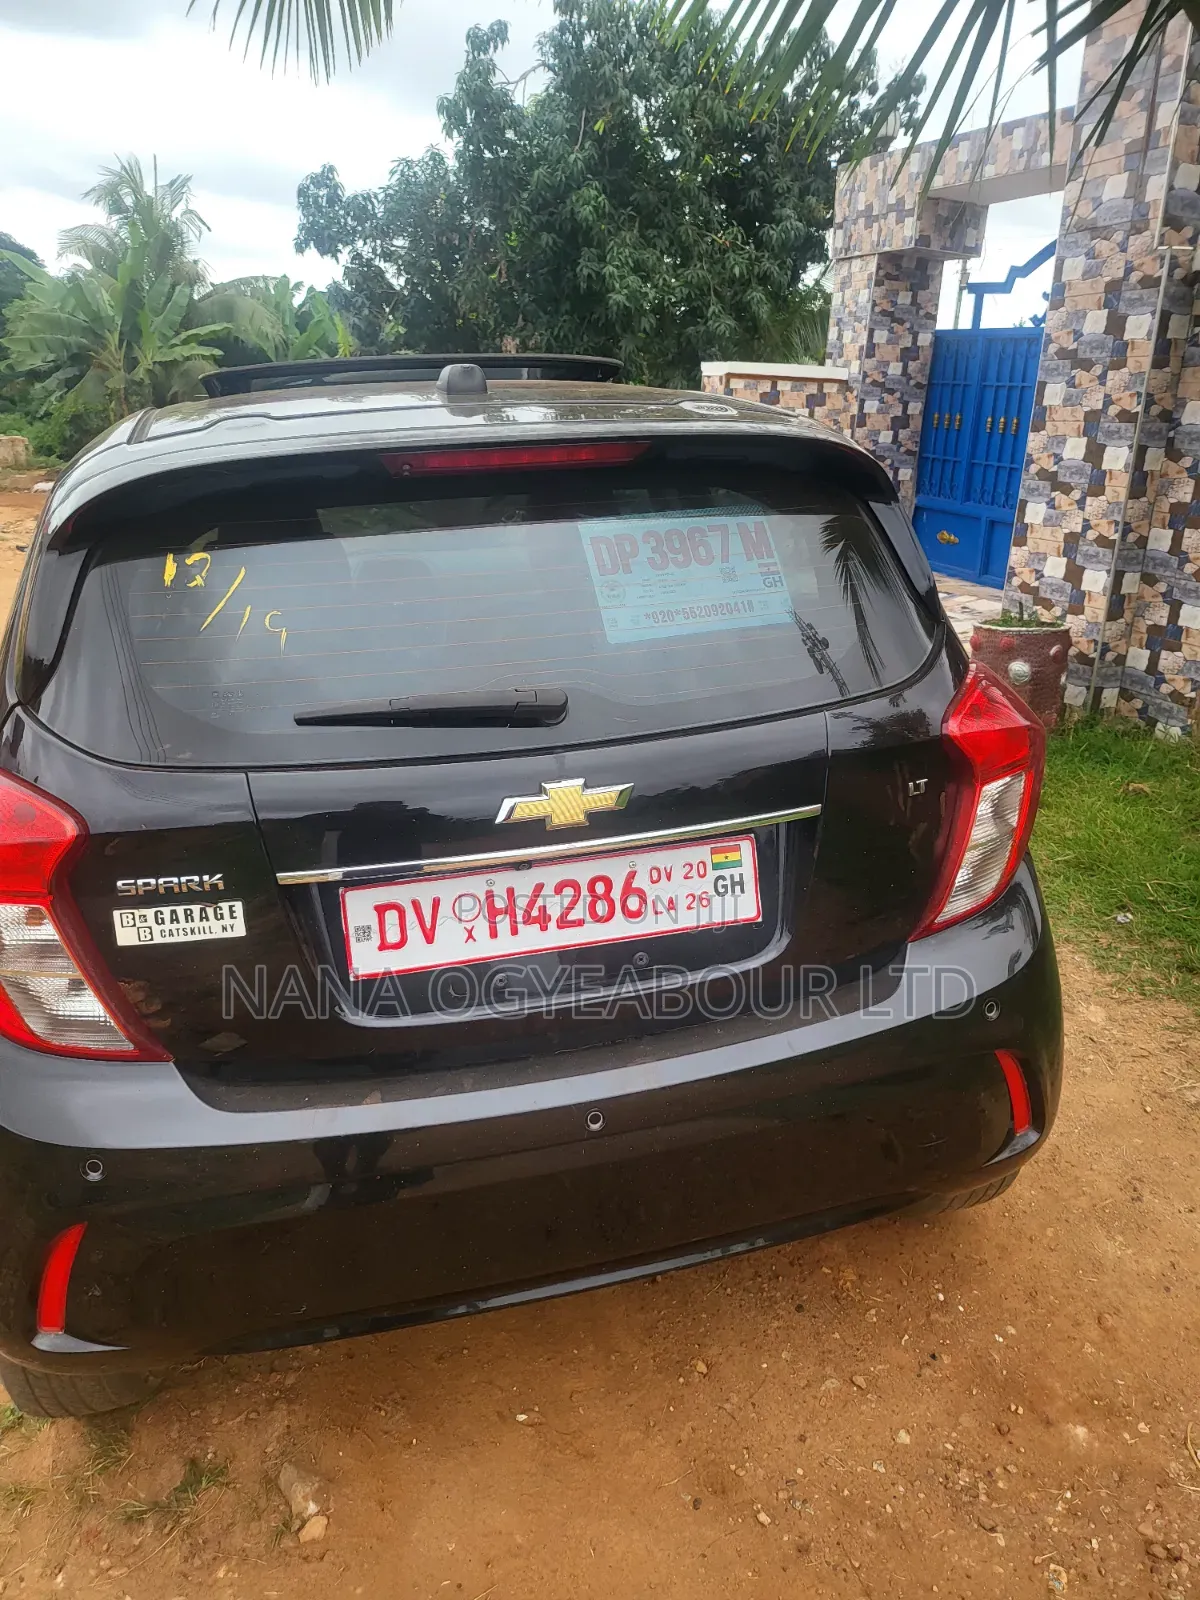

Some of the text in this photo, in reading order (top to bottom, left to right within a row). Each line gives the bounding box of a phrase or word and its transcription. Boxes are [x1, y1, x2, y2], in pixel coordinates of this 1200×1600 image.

[589, 520, 775, 577] DP 3967 M
[762, 575, 785, 589] GH
[908, 778, 929, 797] LT
[682, 860, 708, 880] 20
[116, 873, 225, 896] SPARK
[713, 872, 746, 898] GH
[685, 890, 711, 911] 26
[154, 904, 238, 926] GARAGE
[373, 896, 441, 952] DV
[221, 923, 235, 933] NY
